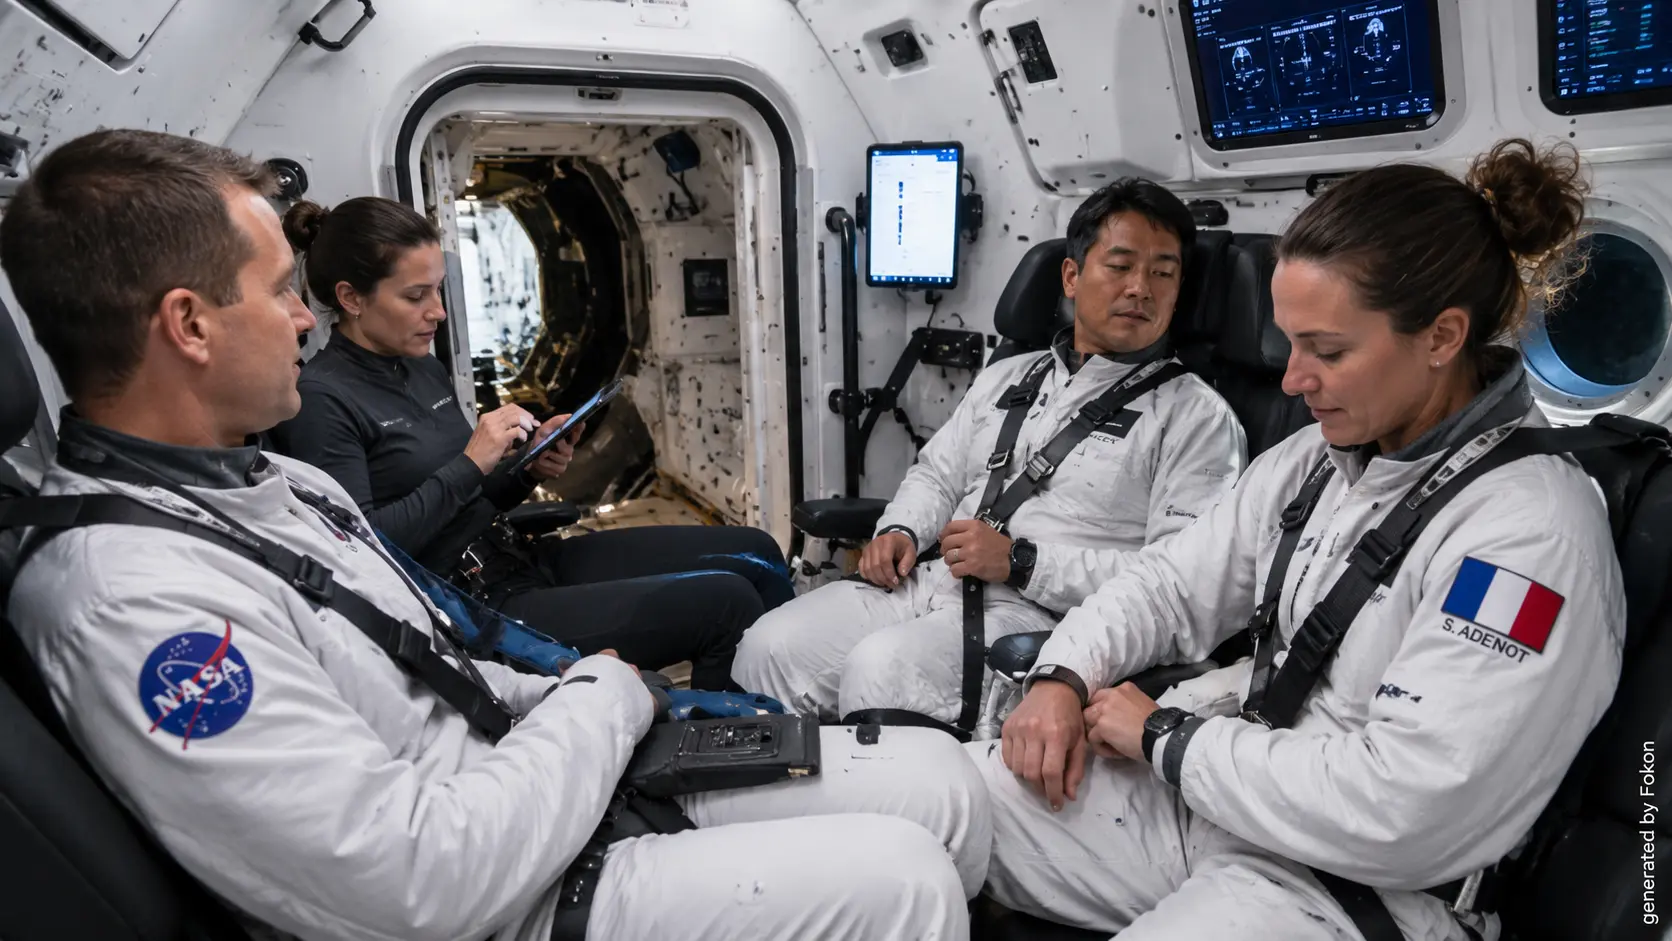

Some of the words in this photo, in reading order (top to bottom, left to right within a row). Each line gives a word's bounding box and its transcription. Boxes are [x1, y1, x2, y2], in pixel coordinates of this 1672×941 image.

[1442, 617, 1455, 634] S.
[1457, 625, 1531, 664] ADENOT
[152, 656, 245, 717] NASA
